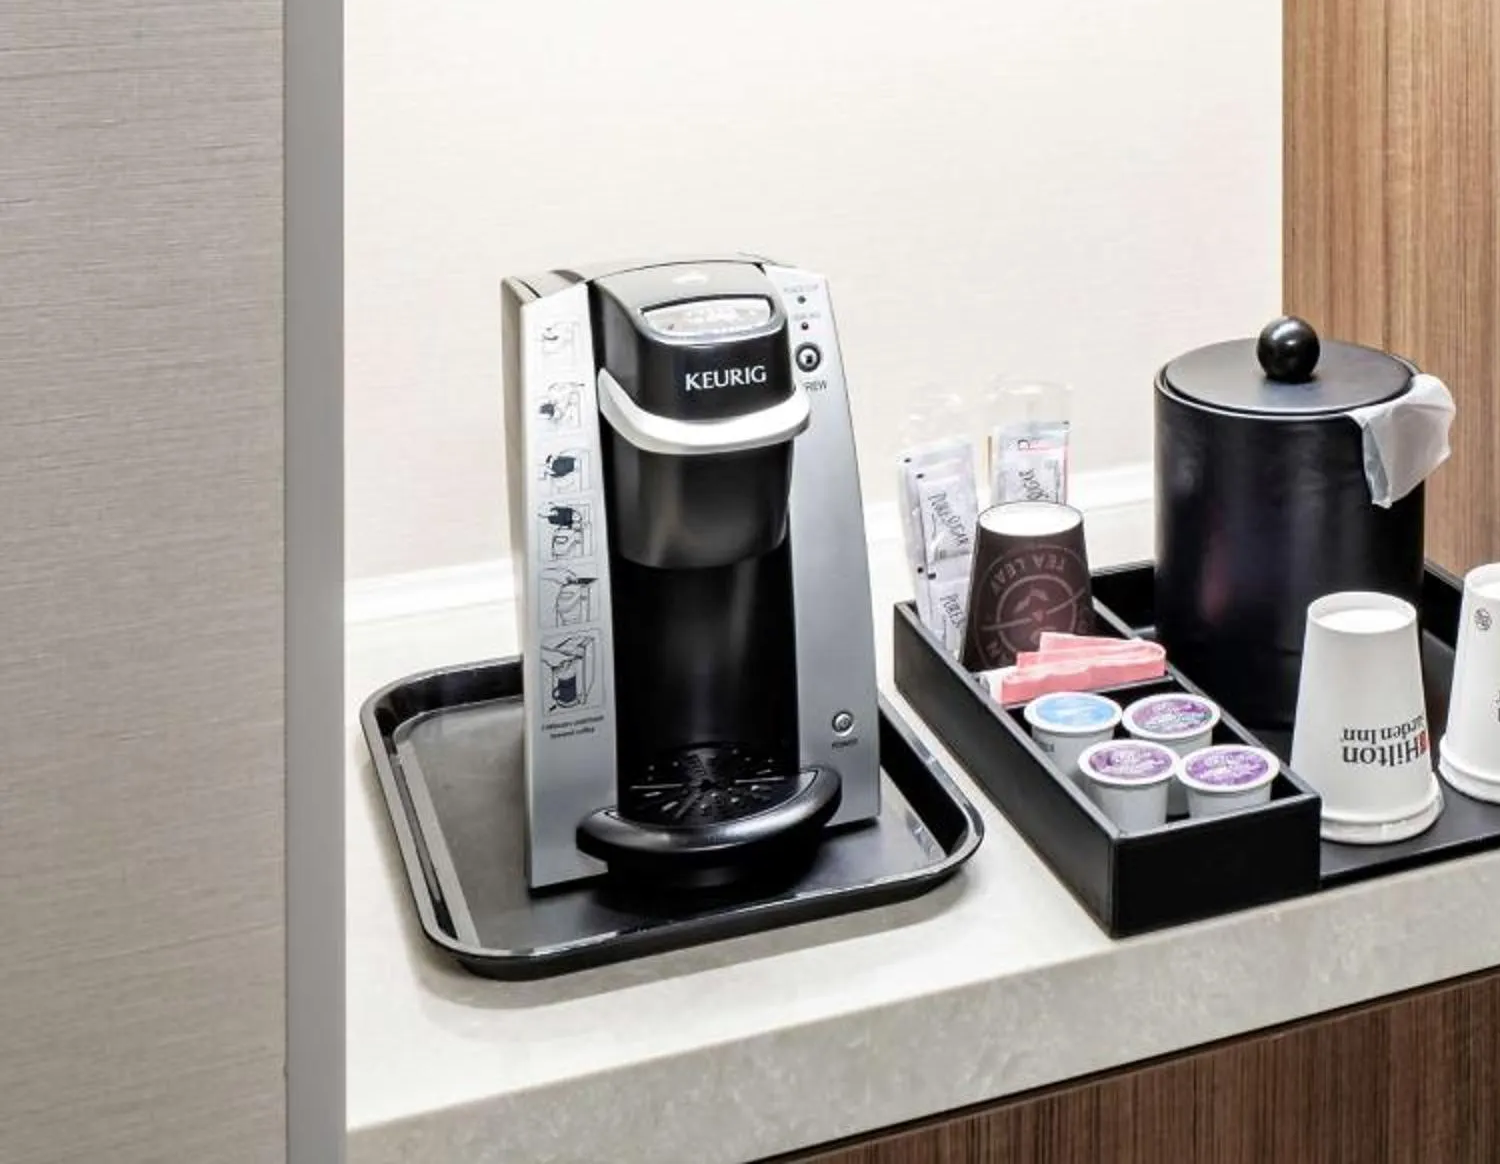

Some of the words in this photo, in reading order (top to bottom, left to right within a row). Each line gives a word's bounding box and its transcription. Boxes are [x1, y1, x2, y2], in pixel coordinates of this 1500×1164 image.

[685, 365, 768, 391] KEURIG
[1343, 728, 1377, 745] Inn
[1381, 715, 1425, 742] rden
[1342, 736, 1419, 767] Hilton
